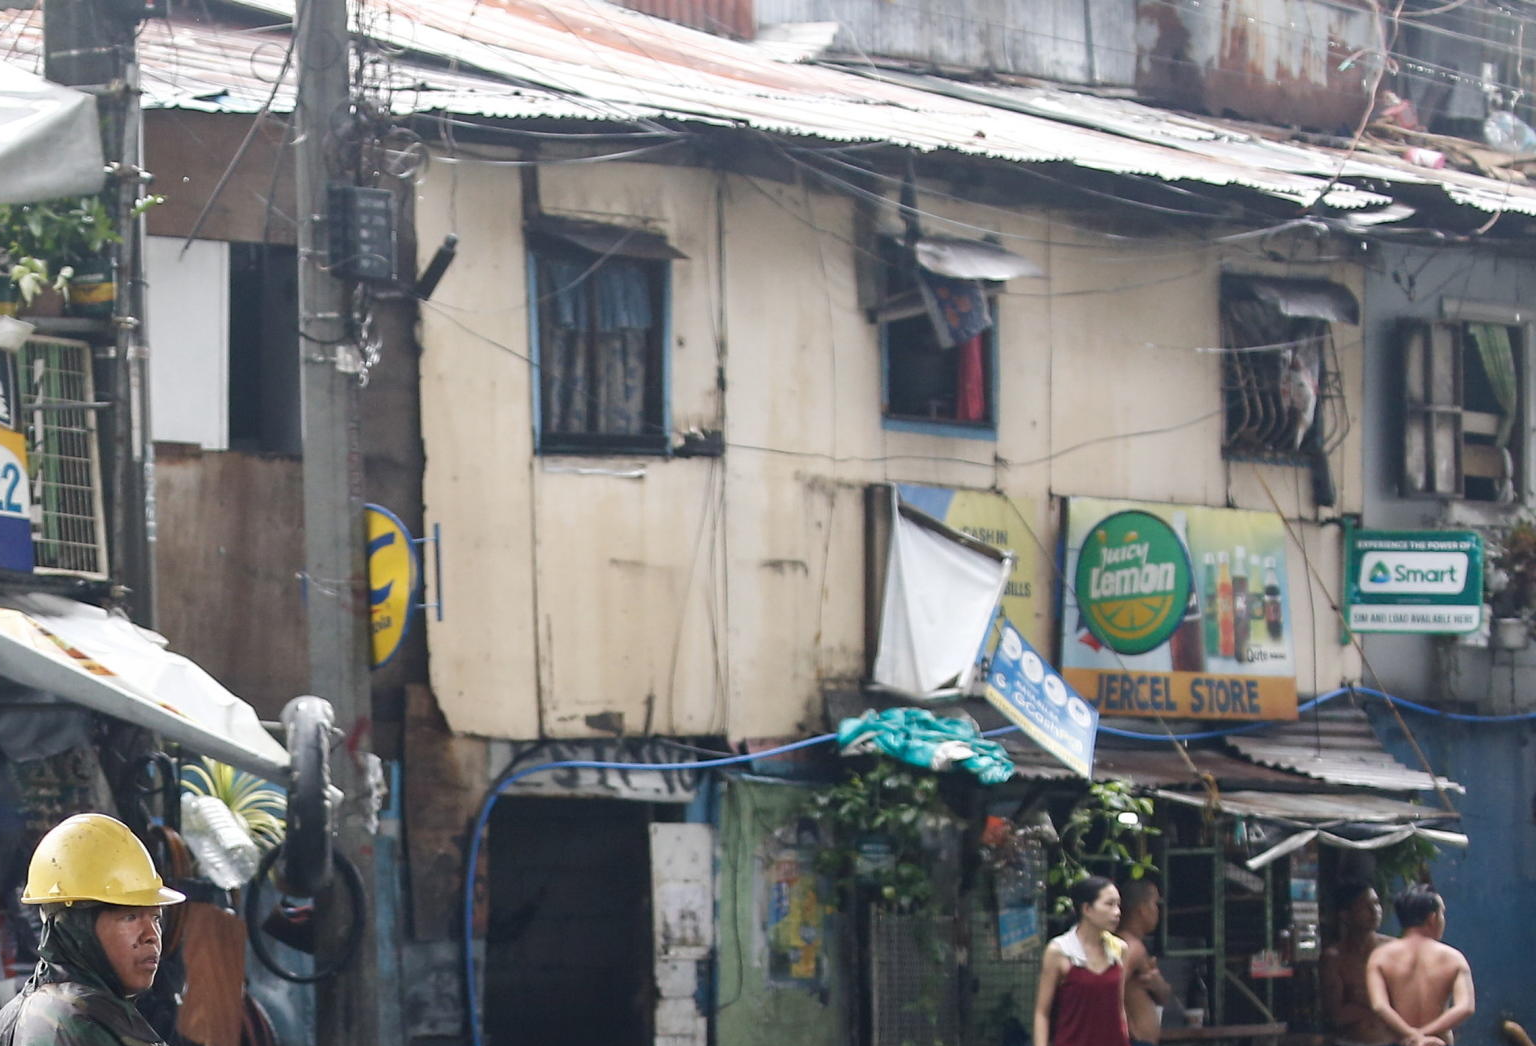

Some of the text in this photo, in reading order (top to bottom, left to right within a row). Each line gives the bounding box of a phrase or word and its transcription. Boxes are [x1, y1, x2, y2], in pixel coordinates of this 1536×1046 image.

[1090, 562, 1176, 599] Lemon
[1395, 564, 1457, 583] Smart
[1371, 613, 1387, 624] AND
[1411, 613, 1450, 625] AVAILABLE
[1090, 673, 1177, 711] JERCEL
[1189, 677, 1261, 714] STORE
